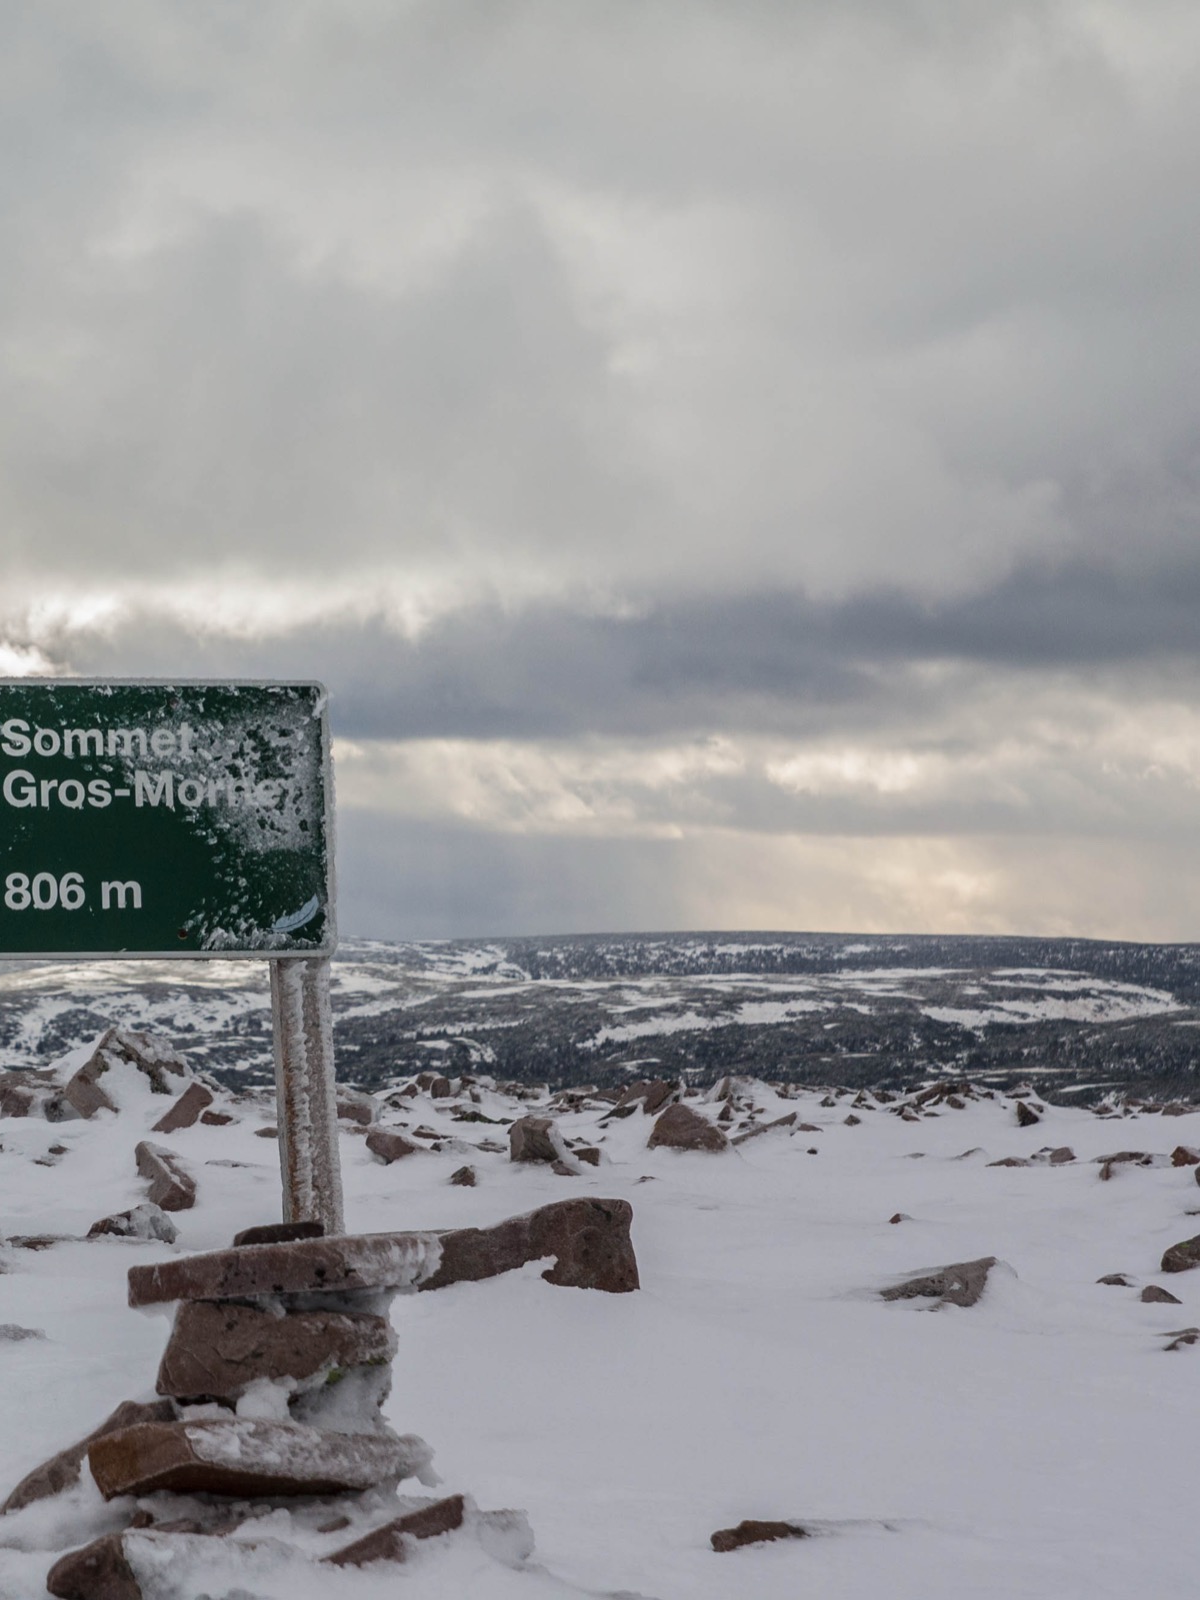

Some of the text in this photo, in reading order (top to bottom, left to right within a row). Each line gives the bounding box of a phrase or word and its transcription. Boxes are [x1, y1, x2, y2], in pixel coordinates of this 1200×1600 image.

[1, 718, 194, 757] Sommet
[4, 872, 142, 911] 806 m
